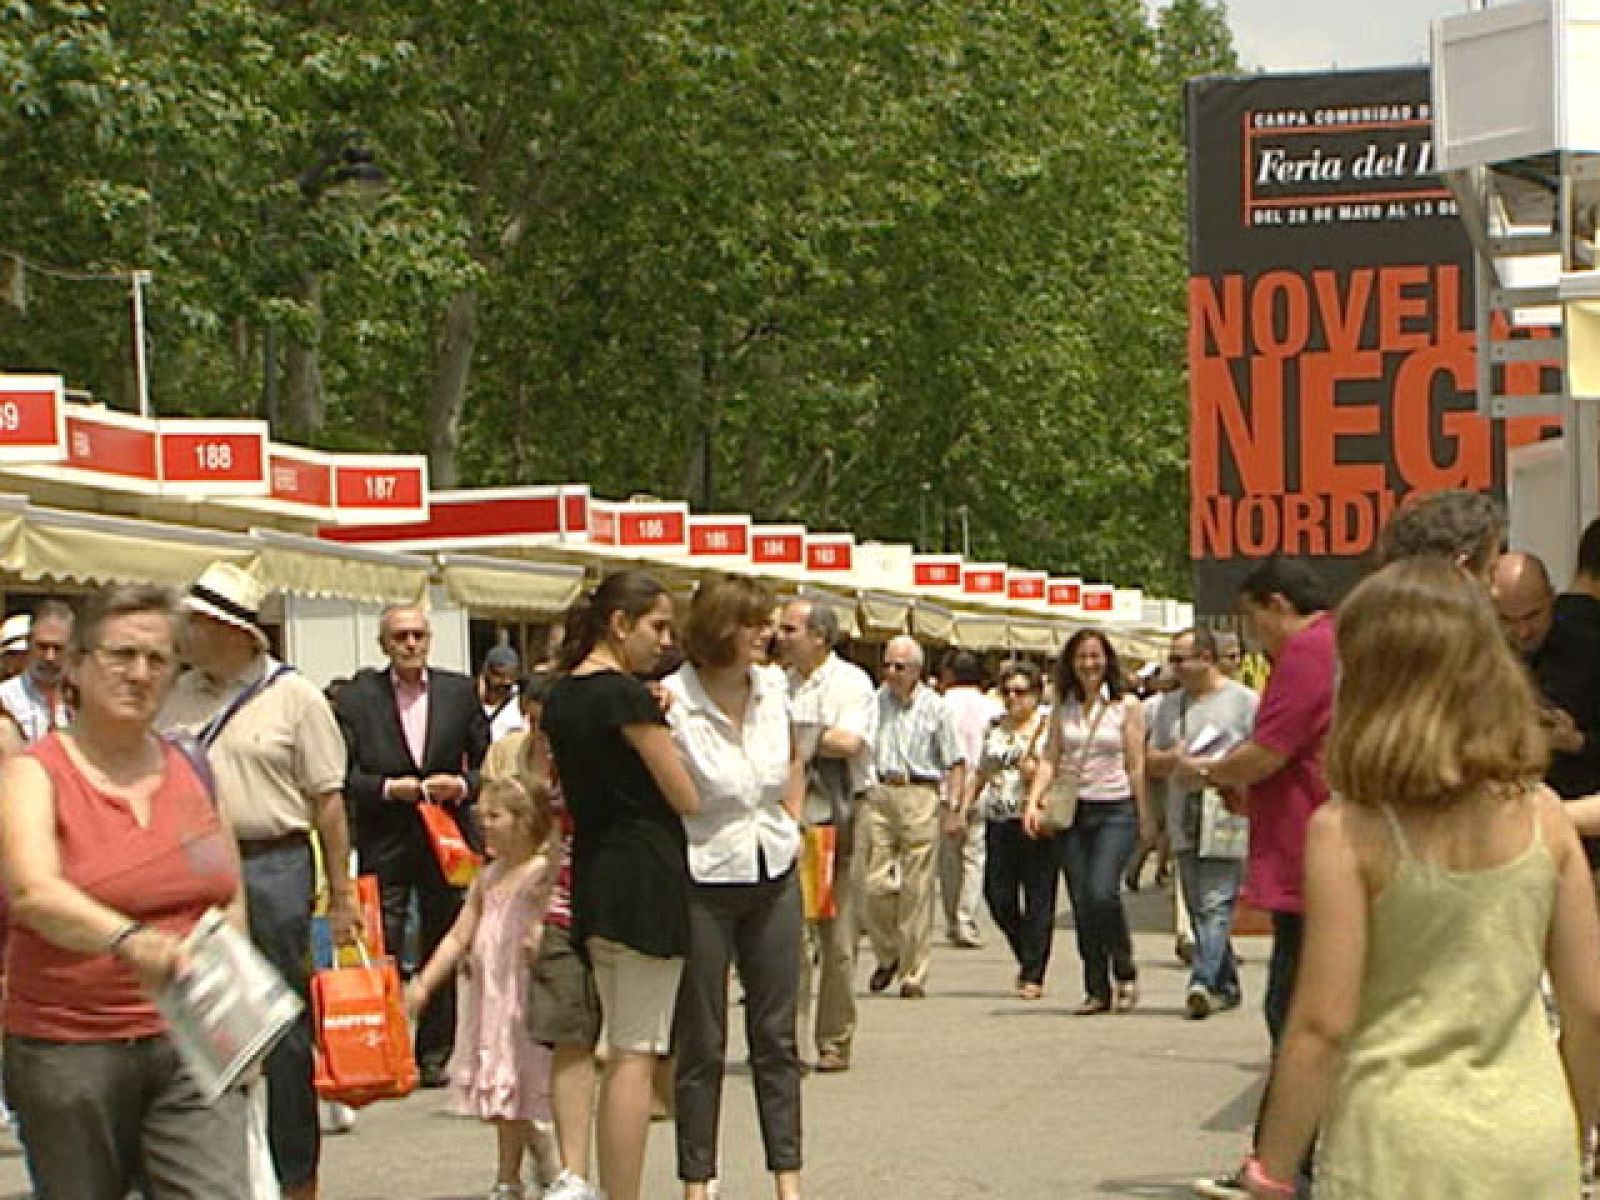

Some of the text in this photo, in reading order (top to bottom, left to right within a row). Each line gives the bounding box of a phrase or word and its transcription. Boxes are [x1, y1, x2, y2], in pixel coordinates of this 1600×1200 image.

[1254, 109, 1308, 128] CARPA
[1314, 104, 1411, 125] COMUNIDAD
[1256, 148, 1341, 185] Feria
[1352, 143, 1408, 177] del
[1254, 208, 1283, 225] DEL
[1313, 206, 1332, 223] DE
[1338, 205, 1381, 221] MAYO
[1387, 203, 1407, 220] AL
[195, 443, 232, 470] 188
[365, 475, 398, 500] 187
